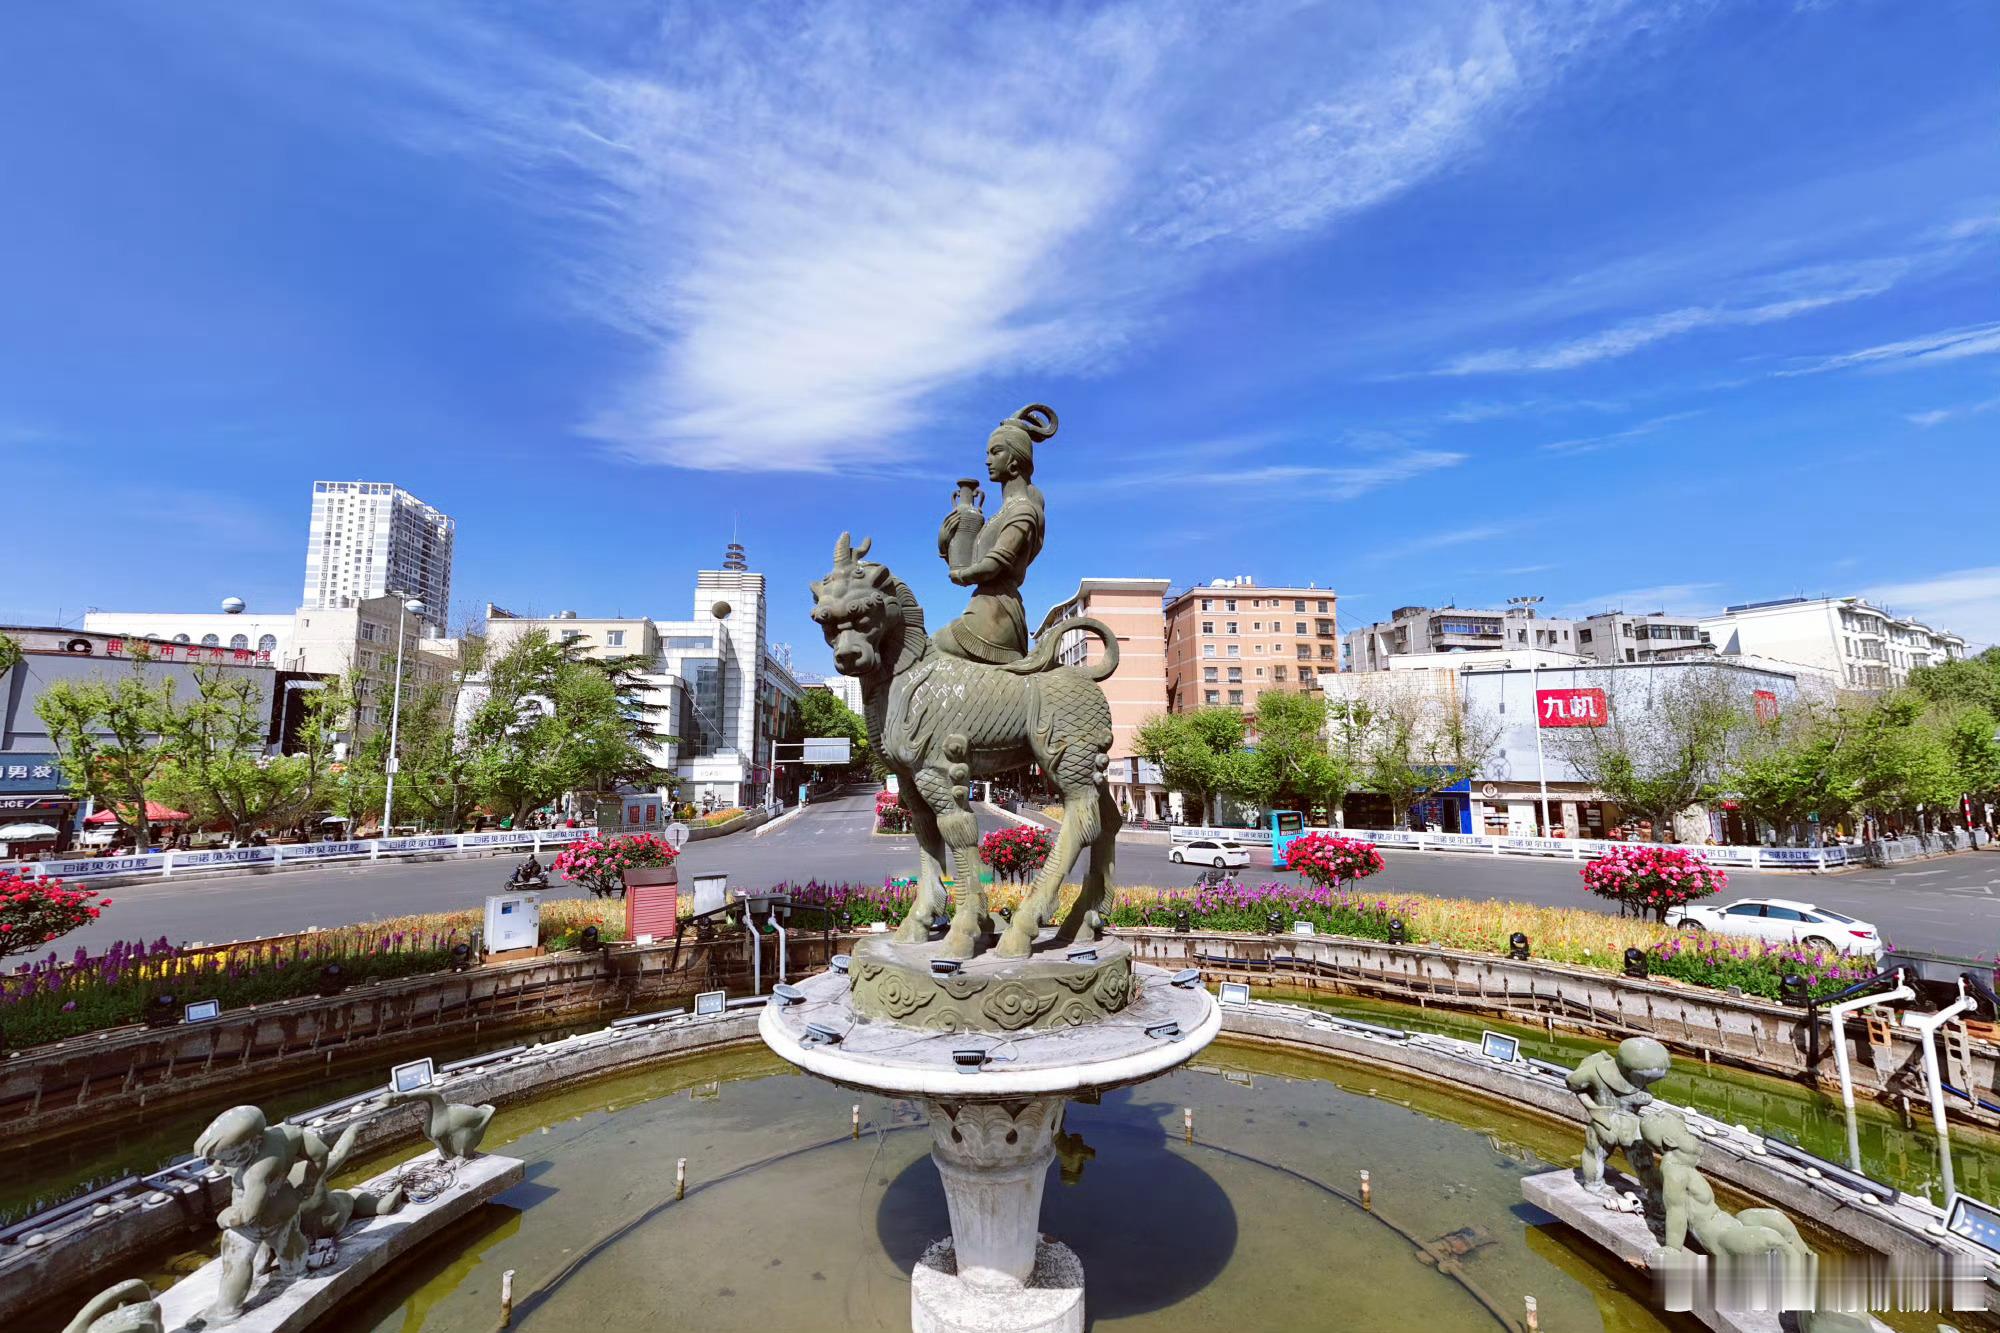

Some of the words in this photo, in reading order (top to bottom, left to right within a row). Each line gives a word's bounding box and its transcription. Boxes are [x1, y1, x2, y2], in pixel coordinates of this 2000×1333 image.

[106, 638, 271, 661] 曲市艺术剧院
[1543, 696, 1597, 718] 九机
[0, 765, 52, 779] 男装
